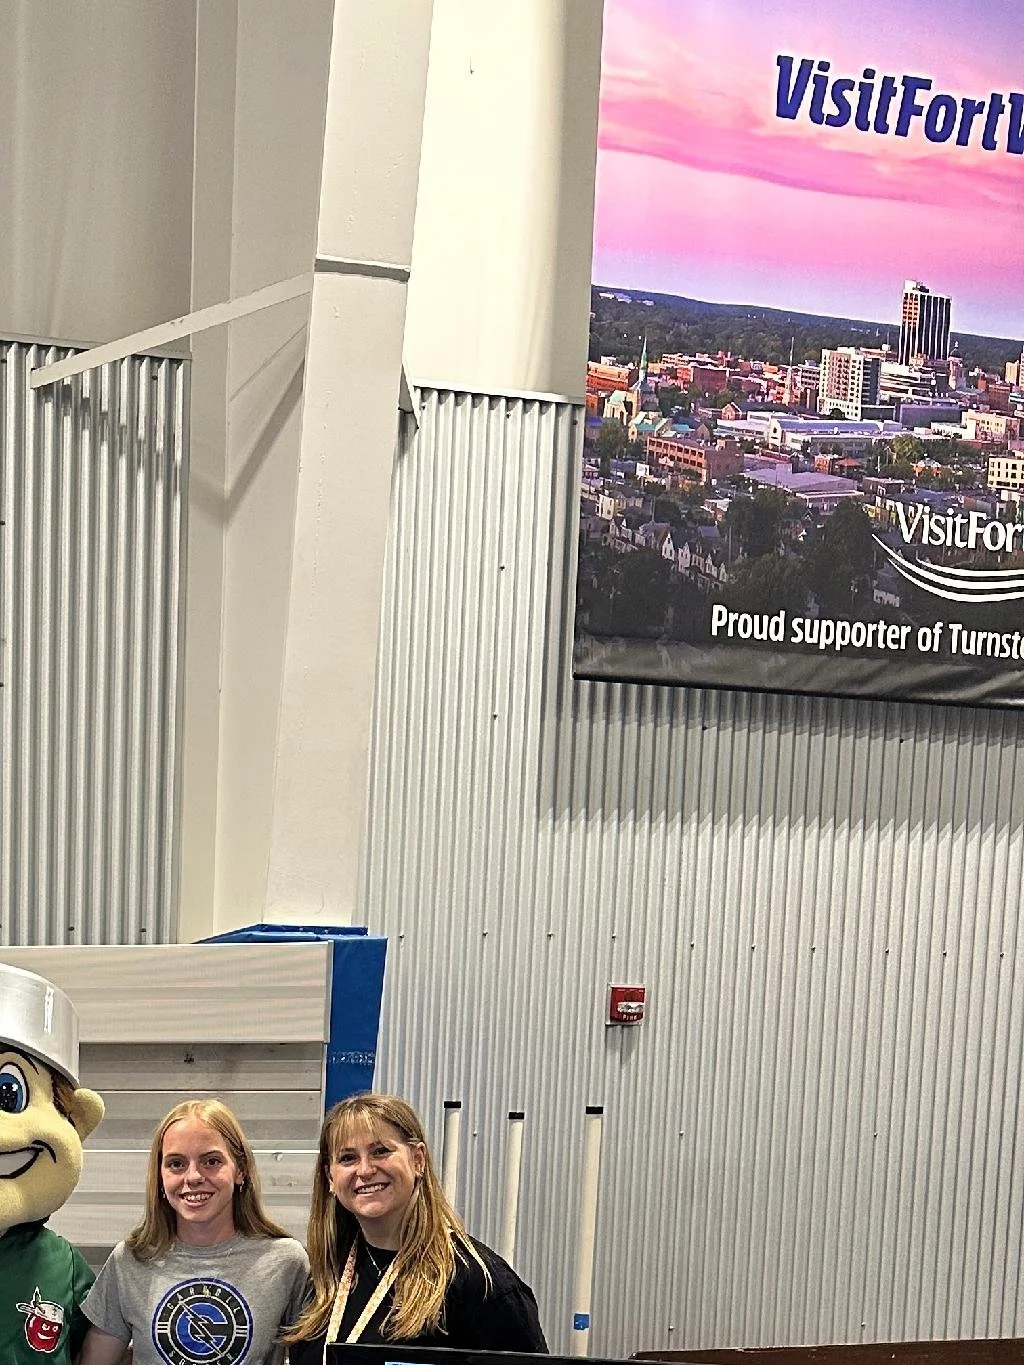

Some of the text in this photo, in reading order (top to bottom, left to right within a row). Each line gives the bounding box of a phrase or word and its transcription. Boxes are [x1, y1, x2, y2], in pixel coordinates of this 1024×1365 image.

[776, 55, 1024, 155] VisitFort
[896, 501, 1024, 553] VisitFor
[711, 604, 786, 642] Proud
[790, 614, 912, 651] supporter
[917, 621, 944, 653] of
